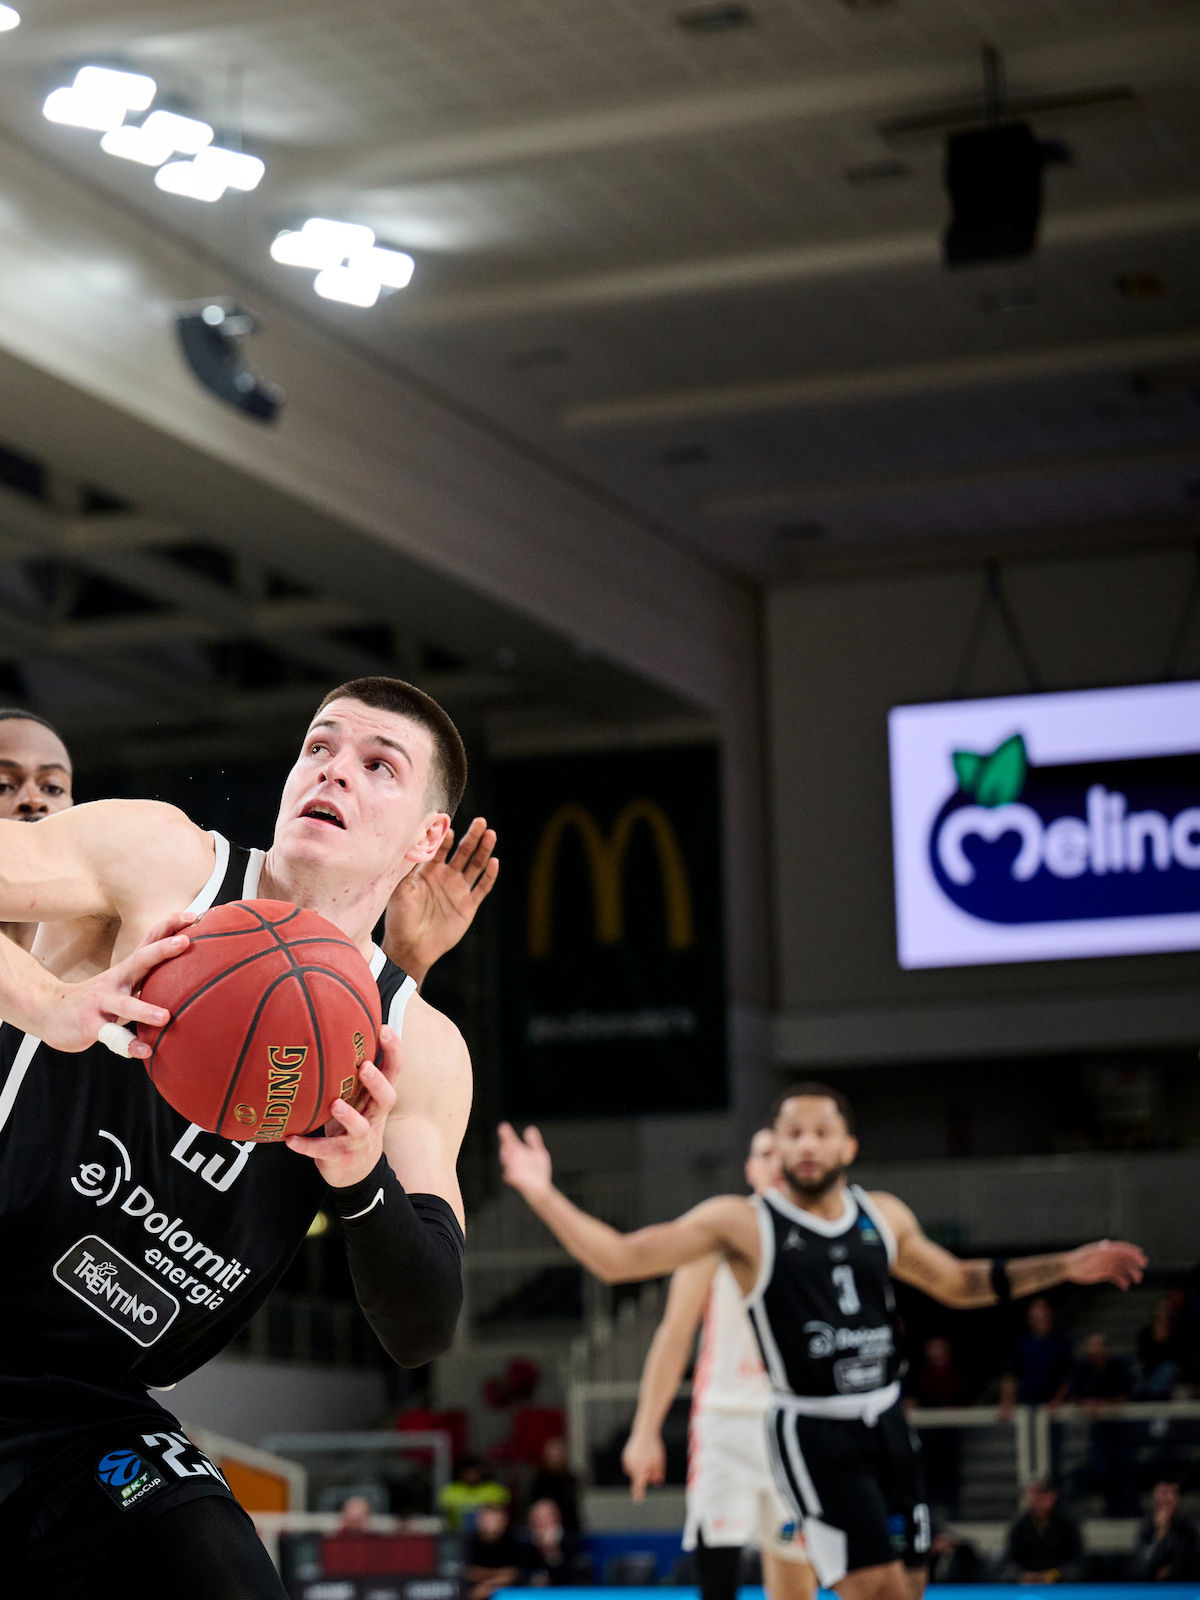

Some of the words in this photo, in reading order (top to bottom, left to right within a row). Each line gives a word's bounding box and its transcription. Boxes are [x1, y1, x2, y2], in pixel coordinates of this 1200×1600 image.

[249, 1046, 308, 1142] PALDING
[121, 1185, 251, 1292] Dolomiti
[74, 1251, 158, 1325] TRENTINO
[145, 1248, 224, 1311] energia
[831, 1264, 861, 1316] 3
[121, 1472, 149, 1499] BKT
[122, 1477, 161, 1507] EuroCup
